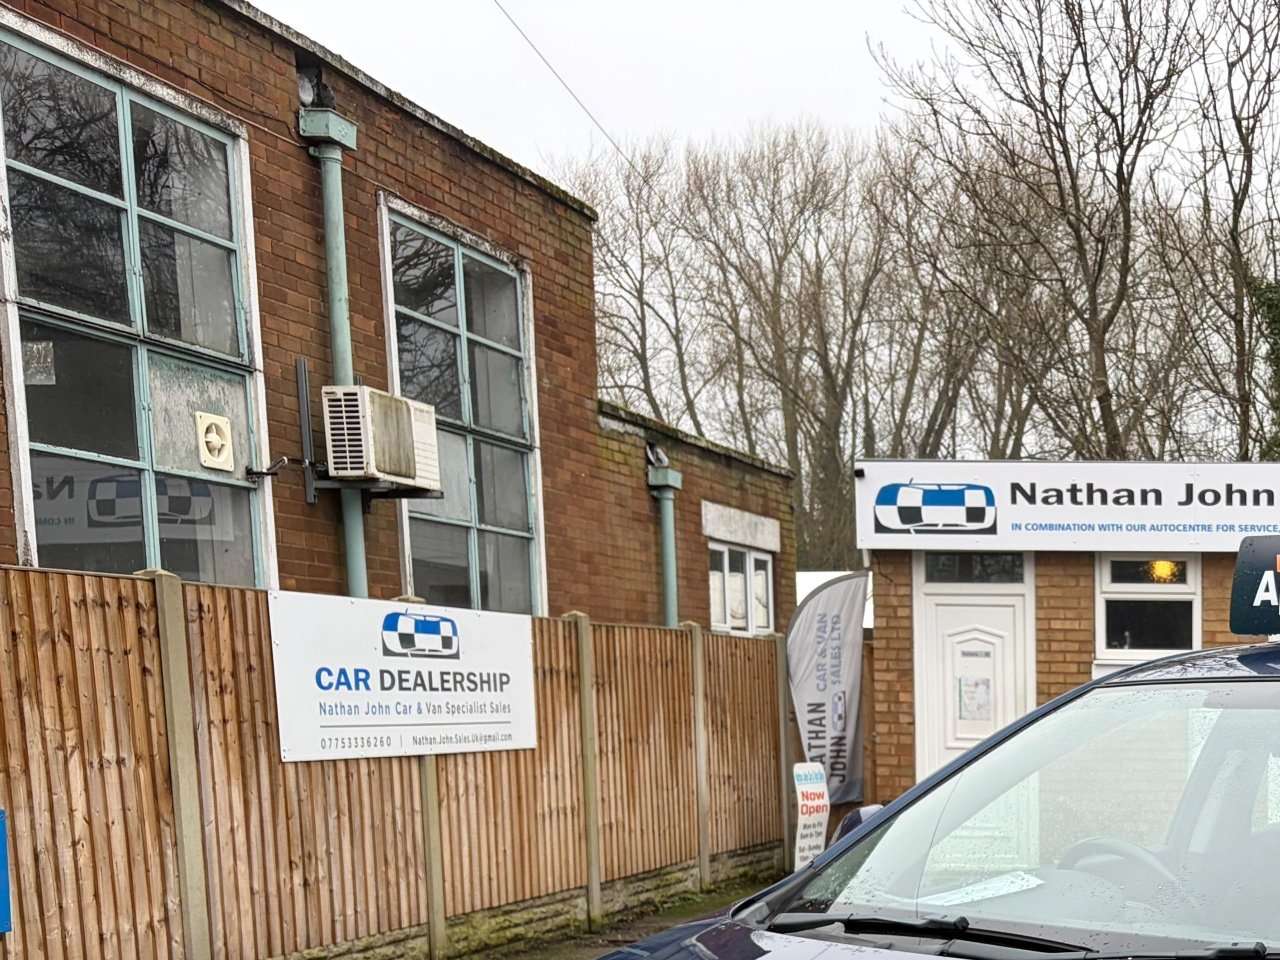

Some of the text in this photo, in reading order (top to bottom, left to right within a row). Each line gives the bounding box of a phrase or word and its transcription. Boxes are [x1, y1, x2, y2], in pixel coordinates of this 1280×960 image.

[1010, 482, 1162, 506] Nathan
[1177, 482, 1275, 507] John
[1011, 523, 1022, 531] IN
[1025, 523, 1095, 532] COMBINATION
[1098, 523, 1122, 532] WITH
[1126, 523, 1146, 532] OUR
[1150, 523, 1213, 533] AUTOCENTRE
[1216, 524, 1235, 533] FOR
[1238, 524, 1280, 534] SERVICE,
[817, 613, 828, 645] VAN
[816, 663, 828, 692] CAR
[831, 646, 842, 685] SALES
[315, 666, 511, 693] CAR DEALERSHIP
[319, 701, 511, 716] Nathan John Car & Van Specialist Sales
[320, 736, 391, 750] 07753336260
[807, 702, 826, 765] ATHAN
[830, 735, 847, 784] JOHN
[801, 790, 825, 801] Now
[800, 803, 828, 816] Open
